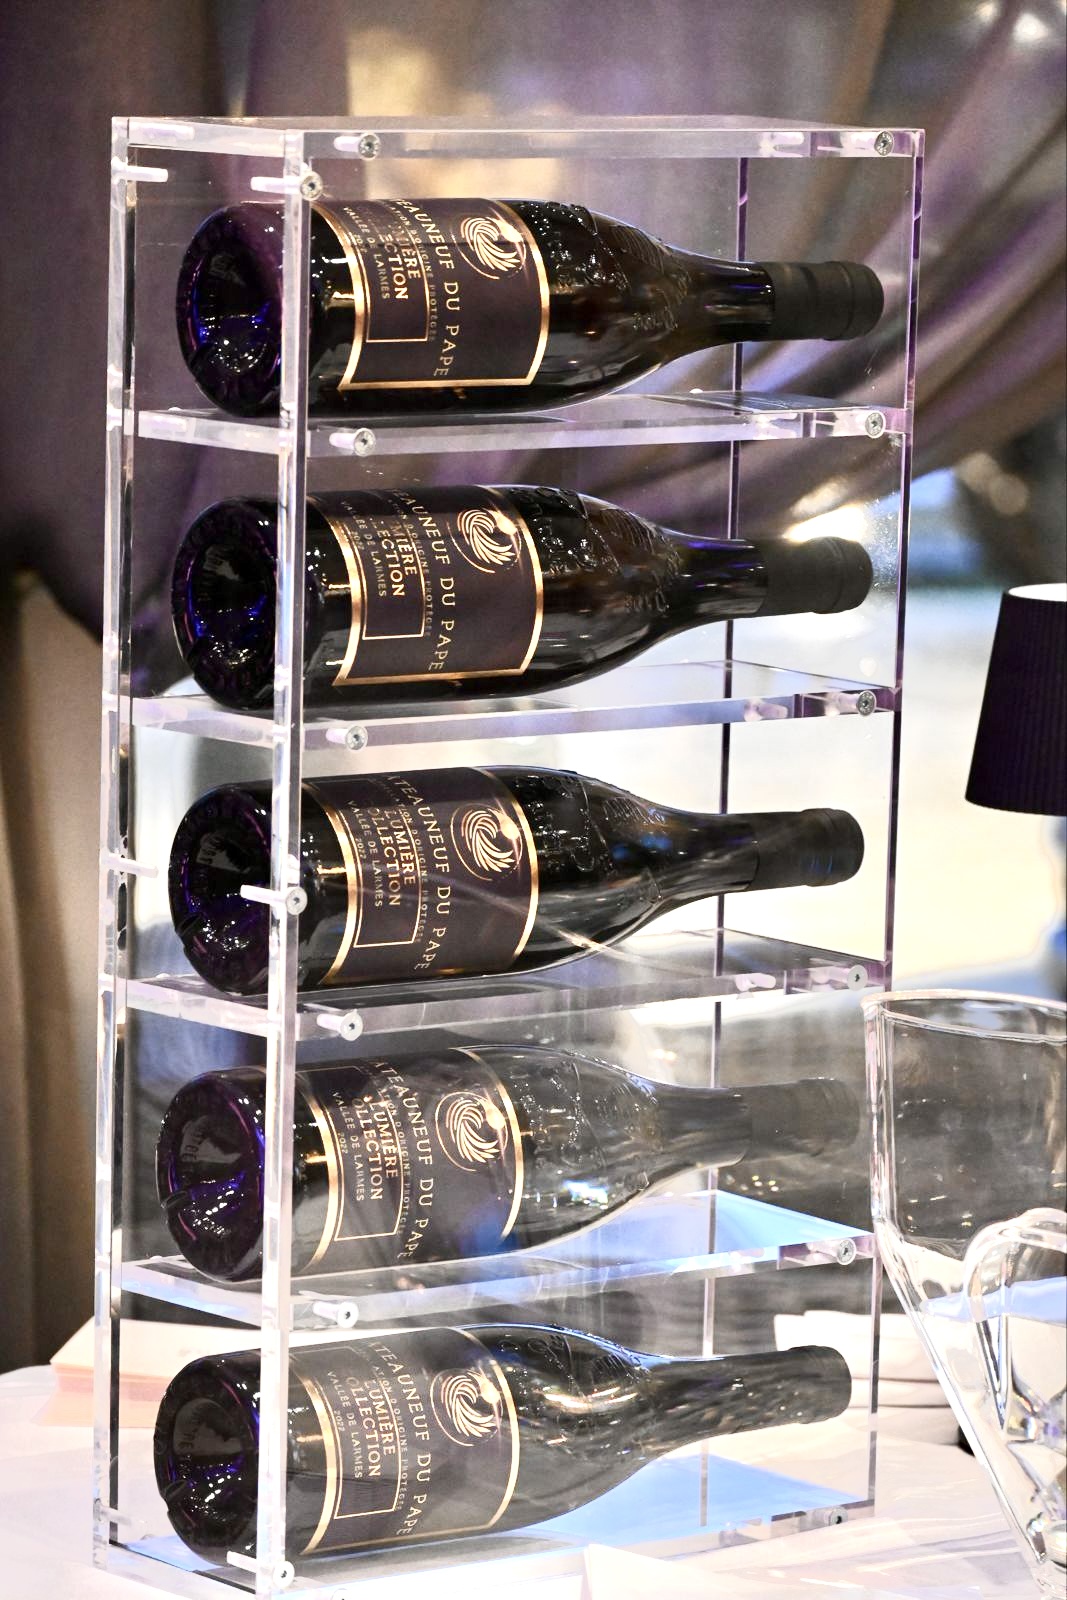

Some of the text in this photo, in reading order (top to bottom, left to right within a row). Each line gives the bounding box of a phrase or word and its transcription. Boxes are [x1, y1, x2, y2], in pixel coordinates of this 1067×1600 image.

[374, 254, 390, 300] LARMES
[444, 282, 460, 311] DU
[433, 325, 460, 376] PAPE
[364, 533, 376, 546] DE
[370, 551, 387, 598] LARMES
[390, 524, 417, 575] MIÈRE
[440, 577, 456, 607] DU
[428, 619, 455, 671] PAPE
[367, 841, 379, 855] DE
[367, 808, 401, 906] OLLECTION
[383, 808, 416, 885] LUMIÈRE
[371, 860, 384, 908] LARMES
[436, 886, 450, 915] DU
[414, 927, 447, 969] PAPE
[337, 1132, 348, 1154] 2022
[350, 1135, 361, 1150] DE
[352, 1098, 384, 1200] OLLECTION
[369, 1100, 399, 1179] LUMIÈRE
[418, 1178, 434, 1207] DU
[397, 1218, 429, 1259] PAPE
[327, 1371, 363, 1479] VALLÉE DE LARMES
[333, 1410, 345, 1432] 2022
[346, 1376, 381, 1477] OLLECTION
[365, 1378, 396, 1456] LUMIÈRE
[416, 1453, 432, 1482] DU
[396, 1494, 428, 1535] PAPE
